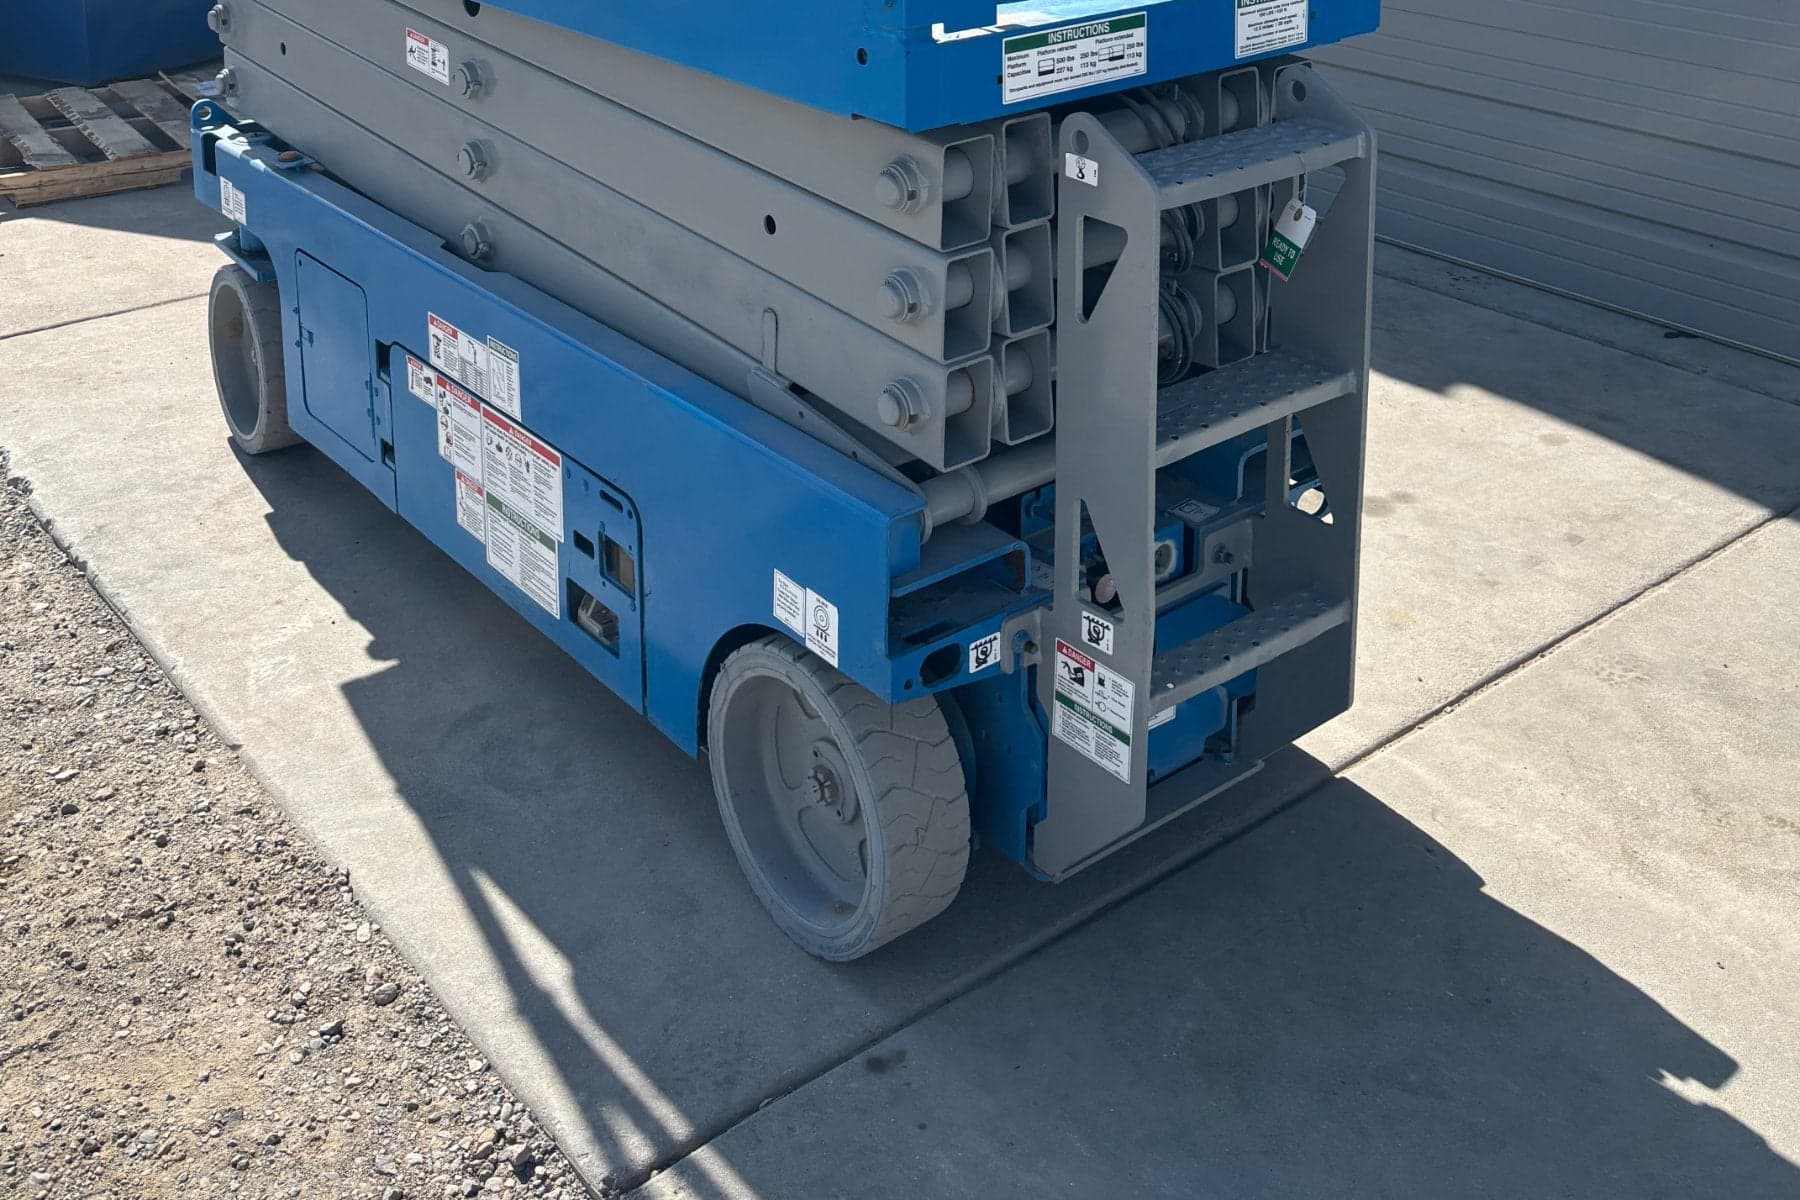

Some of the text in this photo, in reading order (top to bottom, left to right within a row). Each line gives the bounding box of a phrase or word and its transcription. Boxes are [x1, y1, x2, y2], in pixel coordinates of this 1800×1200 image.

[1047, 22, 1110, 44] INSTRUCTIONS
[1095, 36, 1113, 44] Platform
[1037, 47, 1056, 56] Platform
[1066, 65, 1073, 73] kg
[1272, 237, 1288, 255] READY
[1273, 252, 1285, 265] USE
[450, 384, 471, 404] DANGER
[501, 503, 541, 540] INSTRUCTIONS
[1068, 649, 1091, 669] DANGER
[1074, 703, 1113, 734] INSTRUCTIONS
